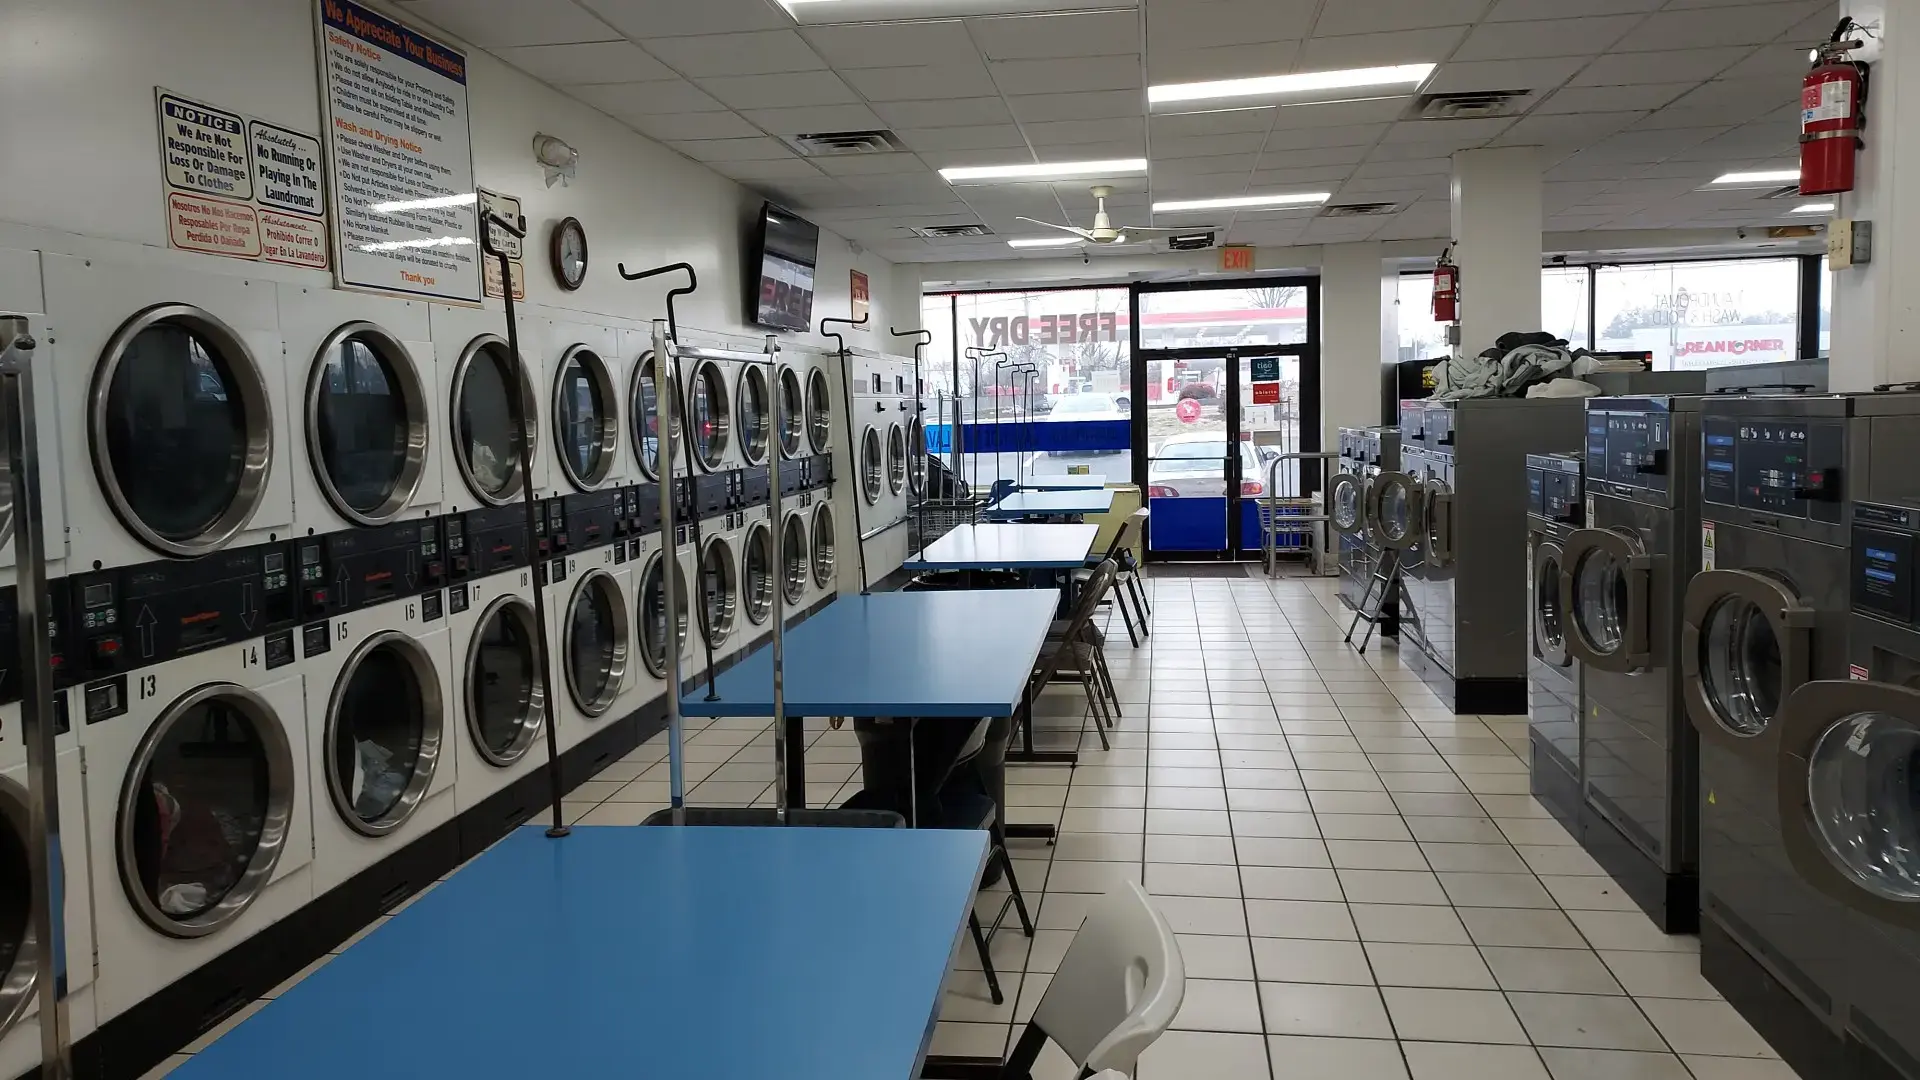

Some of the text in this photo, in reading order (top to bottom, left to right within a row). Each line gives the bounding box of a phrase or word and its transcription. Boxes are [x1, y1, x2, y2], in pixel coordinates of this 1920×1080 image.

[325, 0, 463, 78] We Appreciate Your Business
[328, 31, 381, 62] Safety Notice
[333, 49, 344, 59] You
[344, 55, 353, 63] are
[354, 59, 368, 71] solely
[370, 65, 397, 81] responsible
[405, 80, 415, 88] your
[415, 82, 433, 98] Property
[334, 61, 343, 72] We
[344, 65, 351, 75] do
[352, 70, 361, 78] not
[361, 73, 374, 84] allow
[375, 77, 396, 94] Anybody
[397, 86, 402, 94] to
[402, 89, 411, 98] ride
[412, 92, 416, 100] in
[429, 99, 445, 113] Laundry
[335, 74, 353, 87] Please
[354, 81, 360, 90] do
[361, 85, 370, 94] not
[378, 91, 384, 99] on
[385, 93, 401, 107] folding
[401, 99, 413, 110] Table
[414, 105, 422, 113] and
[336, 86, 358, 101] Children
[359, 96, 372, 106] must
[372, 99, 379, 108] be
[379, 104, 405, 118] supervised
[173, 105, 234, 133] NOTICE
[337, 98, 355, 112] Please
[356, 105, 362, 114] be
[363, 109, 380, 120] careful
[380, 114, 393, 125] Floor
[394, 120, 403, 130] may
[404, 122, 410, 131] be
[411, 125, 428, 139] slippery
[176, 123, 232, 149] We Are Not
[335, 117, 422, 155] Wash and Drying Notice
[168, 136, 244, 166] Responsible For
[256, 144, 316, 172] No Running Or
[340, 134, 357, 146] Please
[358, 140, 373, 151] check
[373, 144, 391, 157] Washer
[392, 151, 401, 160] and
[401, 153, 414, 164] Dryer
[169, 152, 246, 181] Loss Or Damage
[341, 146, 351, 156] Use
[352, 150, 370, 162] Washer
[371, 157, 381, 165] and
[381, 158, 397, 169] Dryers
[403, 166, 413, 174] your
[414, 169, 423, 177] own
[184, 171, 234, 193] To Clothes
[259, 164, 317, 191] Playing In The
[344, 183, 366, 195] Solvents
[370, 168, 397, 181] responsible
[422, 181, 440, 194] Damage
[371, 178, 389, 190] Articles
[172, 198, 201, 214] Nosotros
[201, 204, 210, 215] No
[265, 185, 314, 209] Laundromat
[345, 207, 405, 228] Similarly textured Rubber
[346, 220, 354, 228] No
[355, 222, 369, 231] Horse
[266, 229, 319, 248] Prohibido Correr O
[347, 232, 364, 242] Please
[280, 246, 287, 257] En
[288, 247, 295, 258] La
[395, 252, 406, 262] days
[1224, 251, 1248, 269] EXIT
[400, 271, 435, 286] Thank you
[1728, 339, 1784, 355] KORNER
[568, 559, 576, 574] 19
[520, 572, 528, 587] 18
[472, 585, 481, 601] 17
[404, 602, 415, 621] 16
[337, 622, 348, 641] 15
[242, 647, 258, 669] 14
[140, 675, 156, 700] 13
